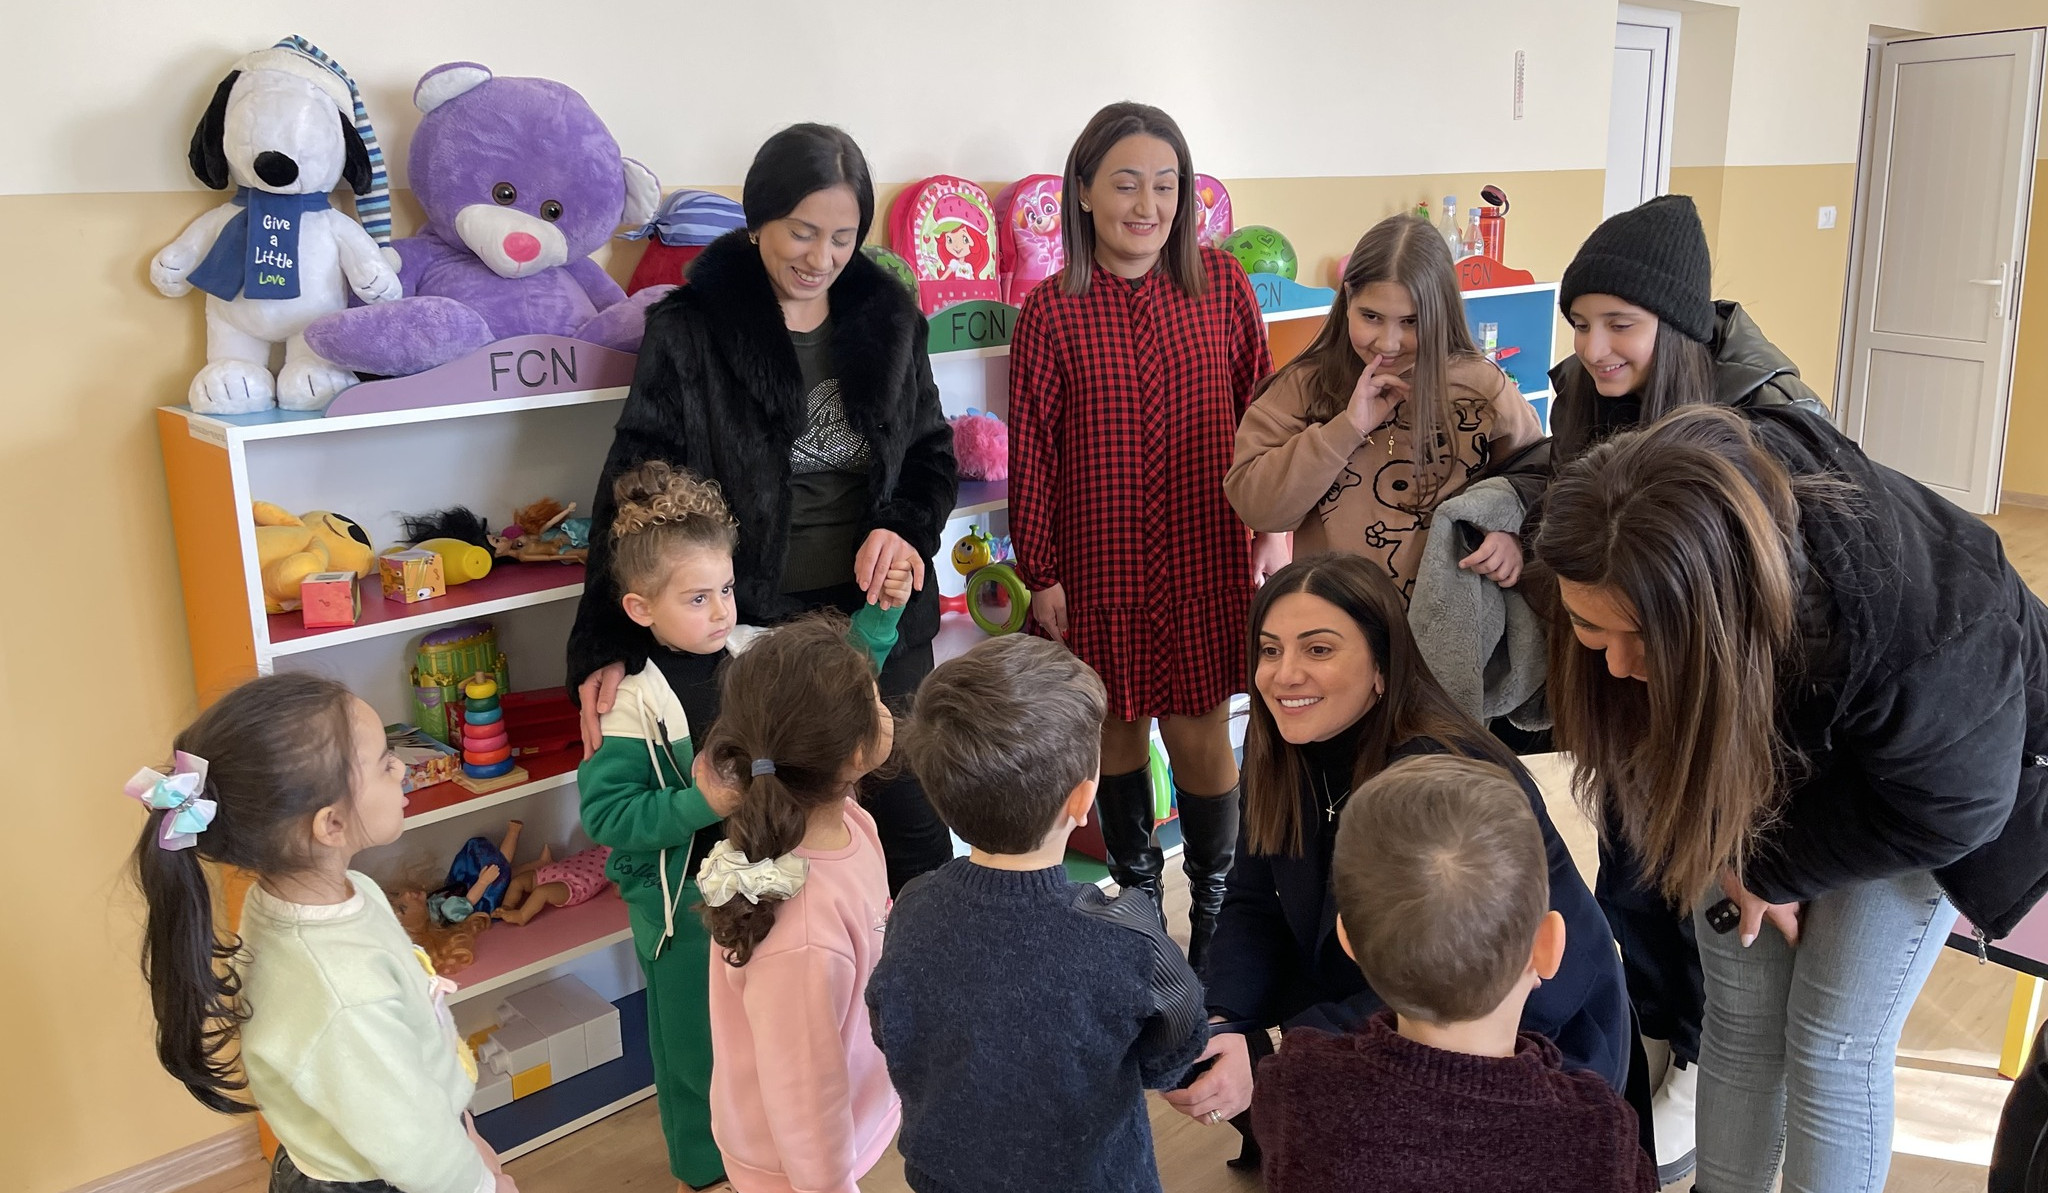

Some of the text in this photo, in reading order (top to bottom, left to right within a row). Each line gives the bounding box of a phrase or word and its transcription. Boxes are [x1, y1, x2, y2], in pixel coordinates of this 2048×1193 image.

[263, 214, 291, 231] Give
[269, 234, 279, 248] a
[255, 246, 294, 269] Little
[258, 271, 286, 287] Love
[1461, 261, 1493, 287] FCN
[1254, 281, 1282, 308] CN
[952, 308, 1006, 345] FCN
[489, 345, 578, 392] FCN
[613, 854, 662, 890] Colleg
